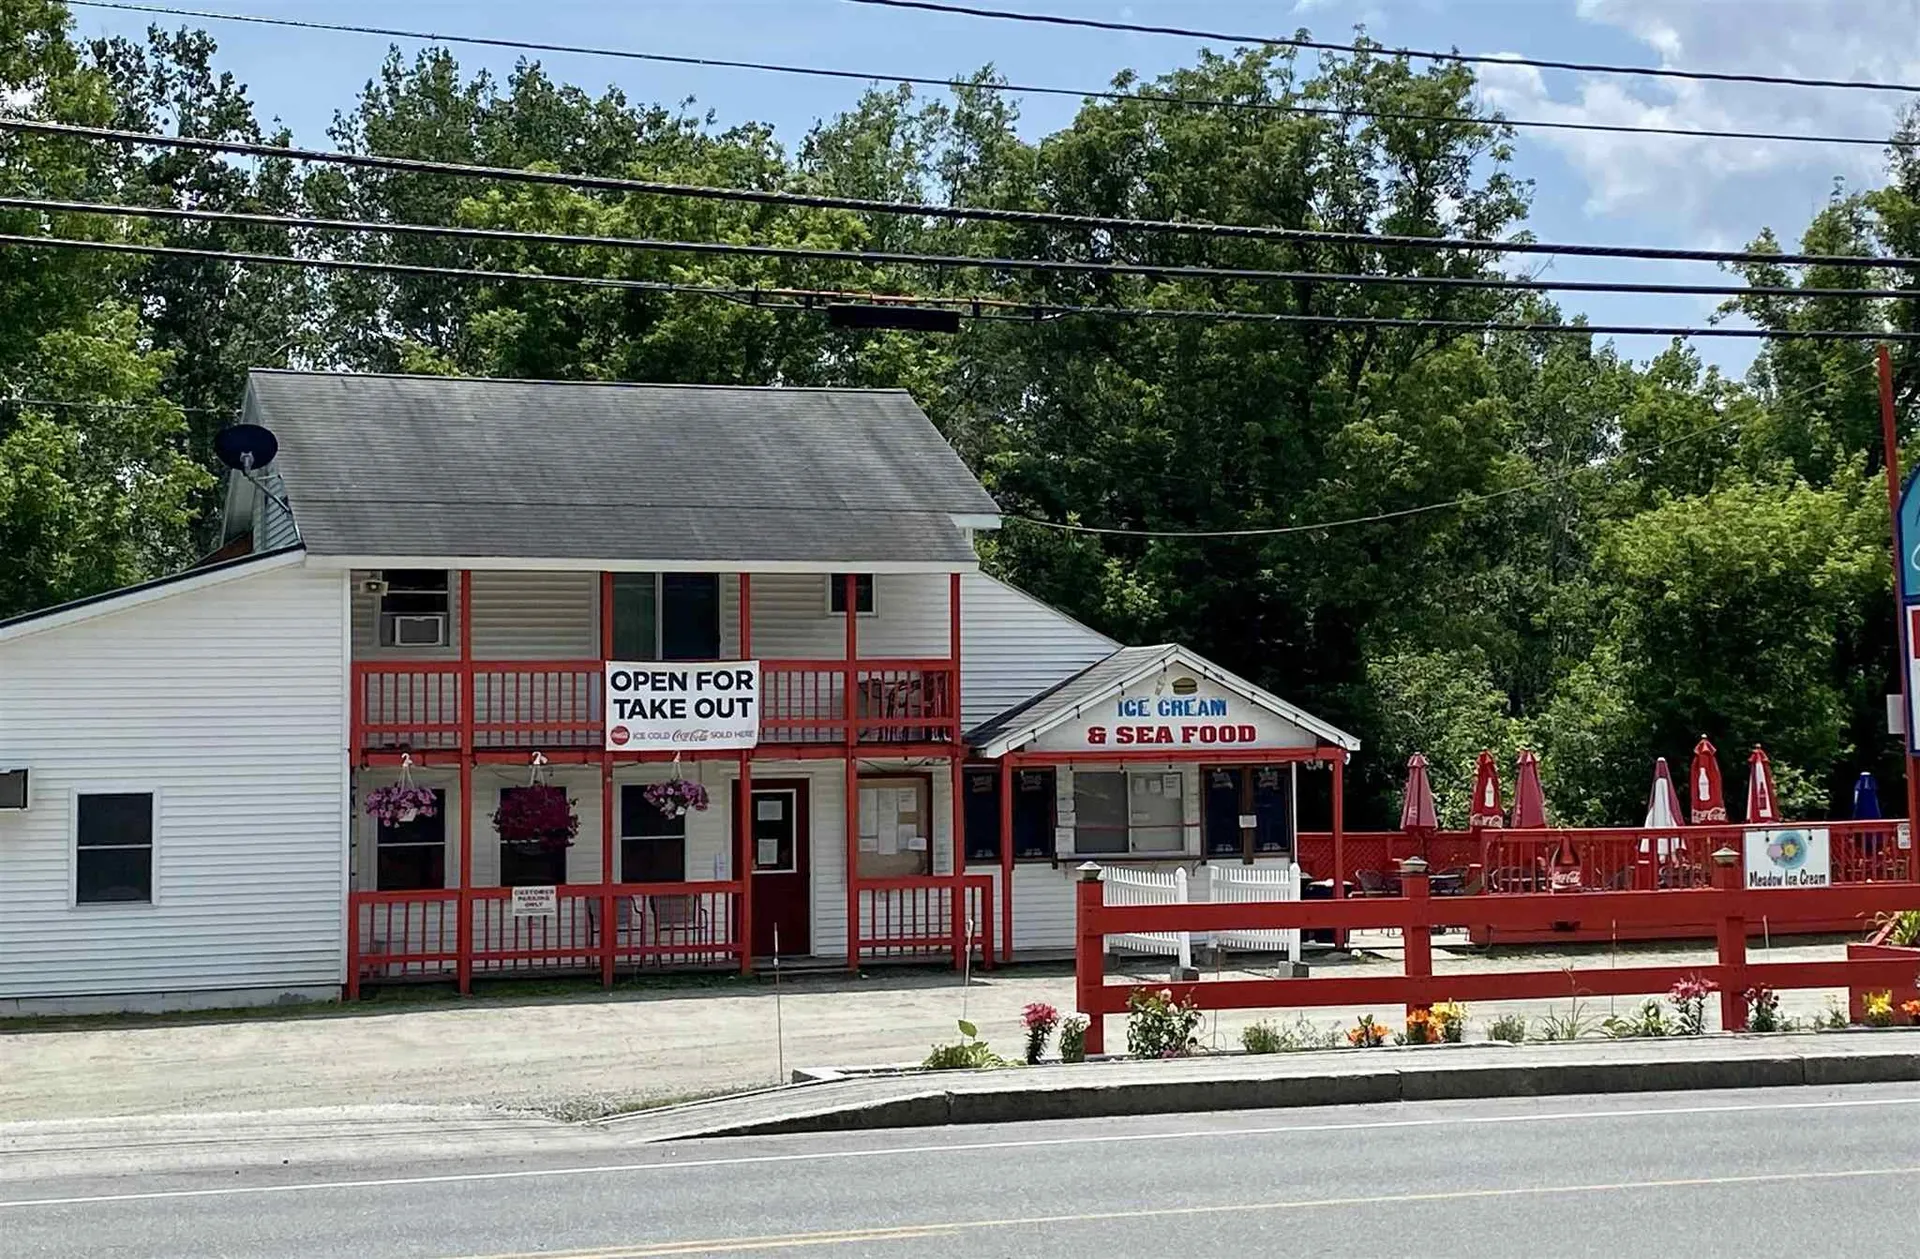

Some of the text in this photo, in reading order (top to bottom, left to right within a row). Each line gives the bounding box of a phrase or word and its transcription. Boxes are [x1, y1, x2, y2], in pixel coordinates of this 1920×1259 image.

[611, 670, 754, 691] OPEN FOR
[613, 697, 754, 720] TAKE OUT
[1117, 697, 1227, 717] ICE CREAM
[633, 732, 646, 740] ICE
[647, 732, 671, 740] COLD
[710, 731, 733, 739] SOLD
[734, 730, 755, 738] HERE
[1087, 724, 1257, 745] & SEA FOOD
[1749, 868, 1826, 887] Meadow Ice Cream
